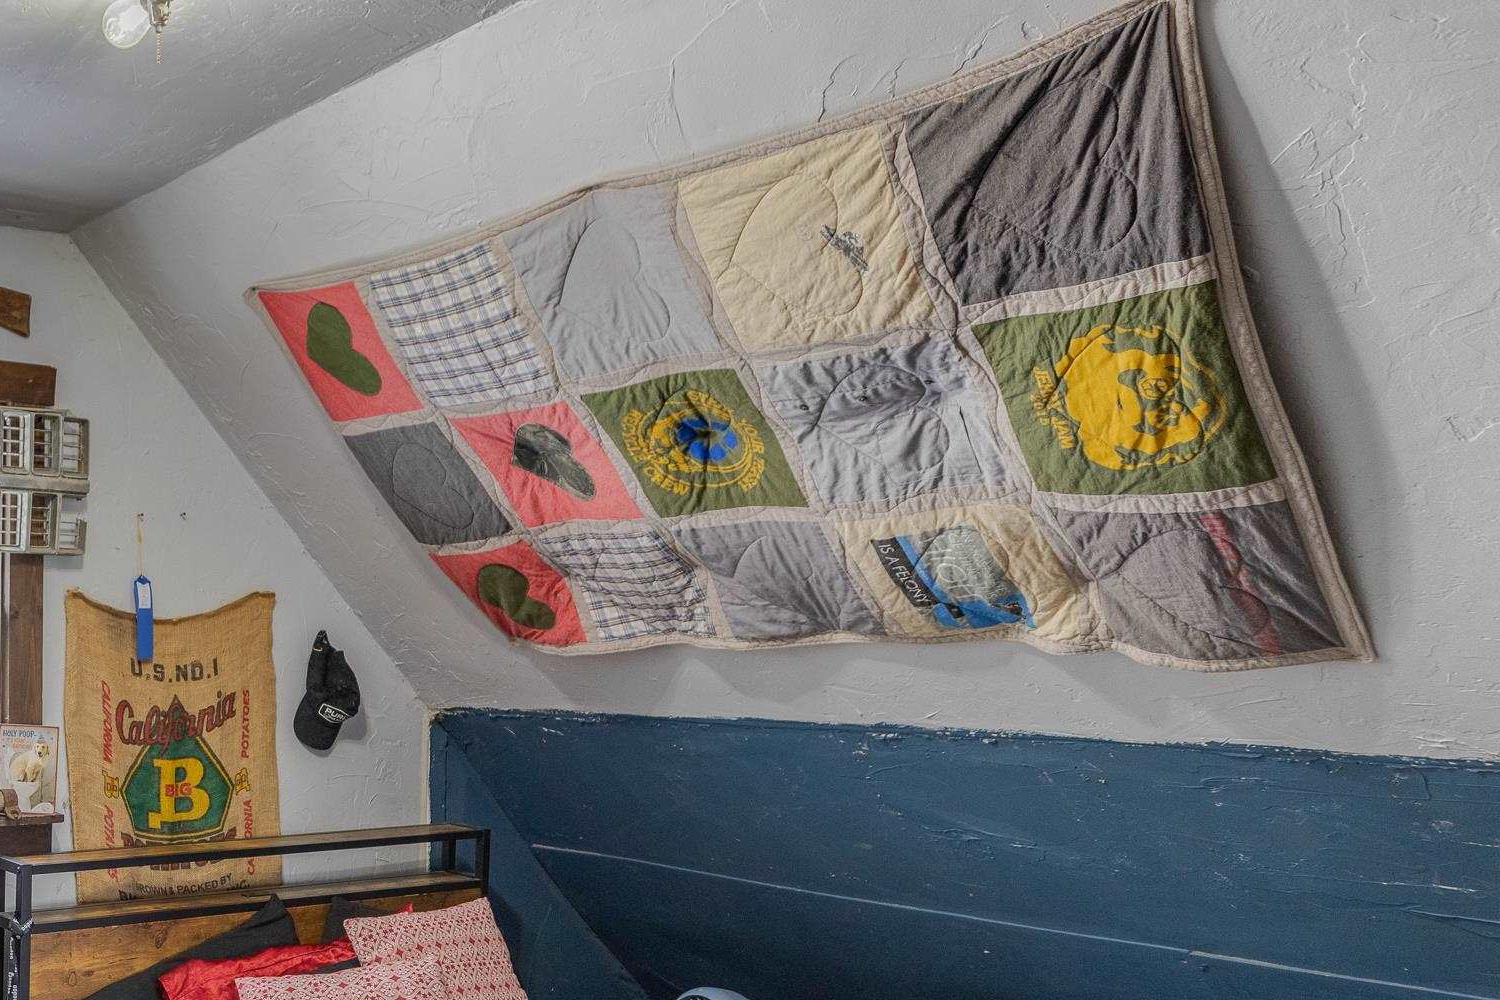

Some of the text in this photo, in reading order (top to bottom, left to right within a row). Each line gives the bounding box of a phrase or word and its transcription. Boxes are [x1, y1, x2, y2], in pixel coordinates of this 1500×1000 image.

[878, 543, 930, 603] IS A FELONY
[100, 680, 114, 763] CALIFORNIA
[115, 690, 237, 757] California
[241, 689, 250, 758] POTATOES
[147, 756, 211, 829] B
[176, 879, 219, 895] PACKED
[219, 873, 232, 886] BY
